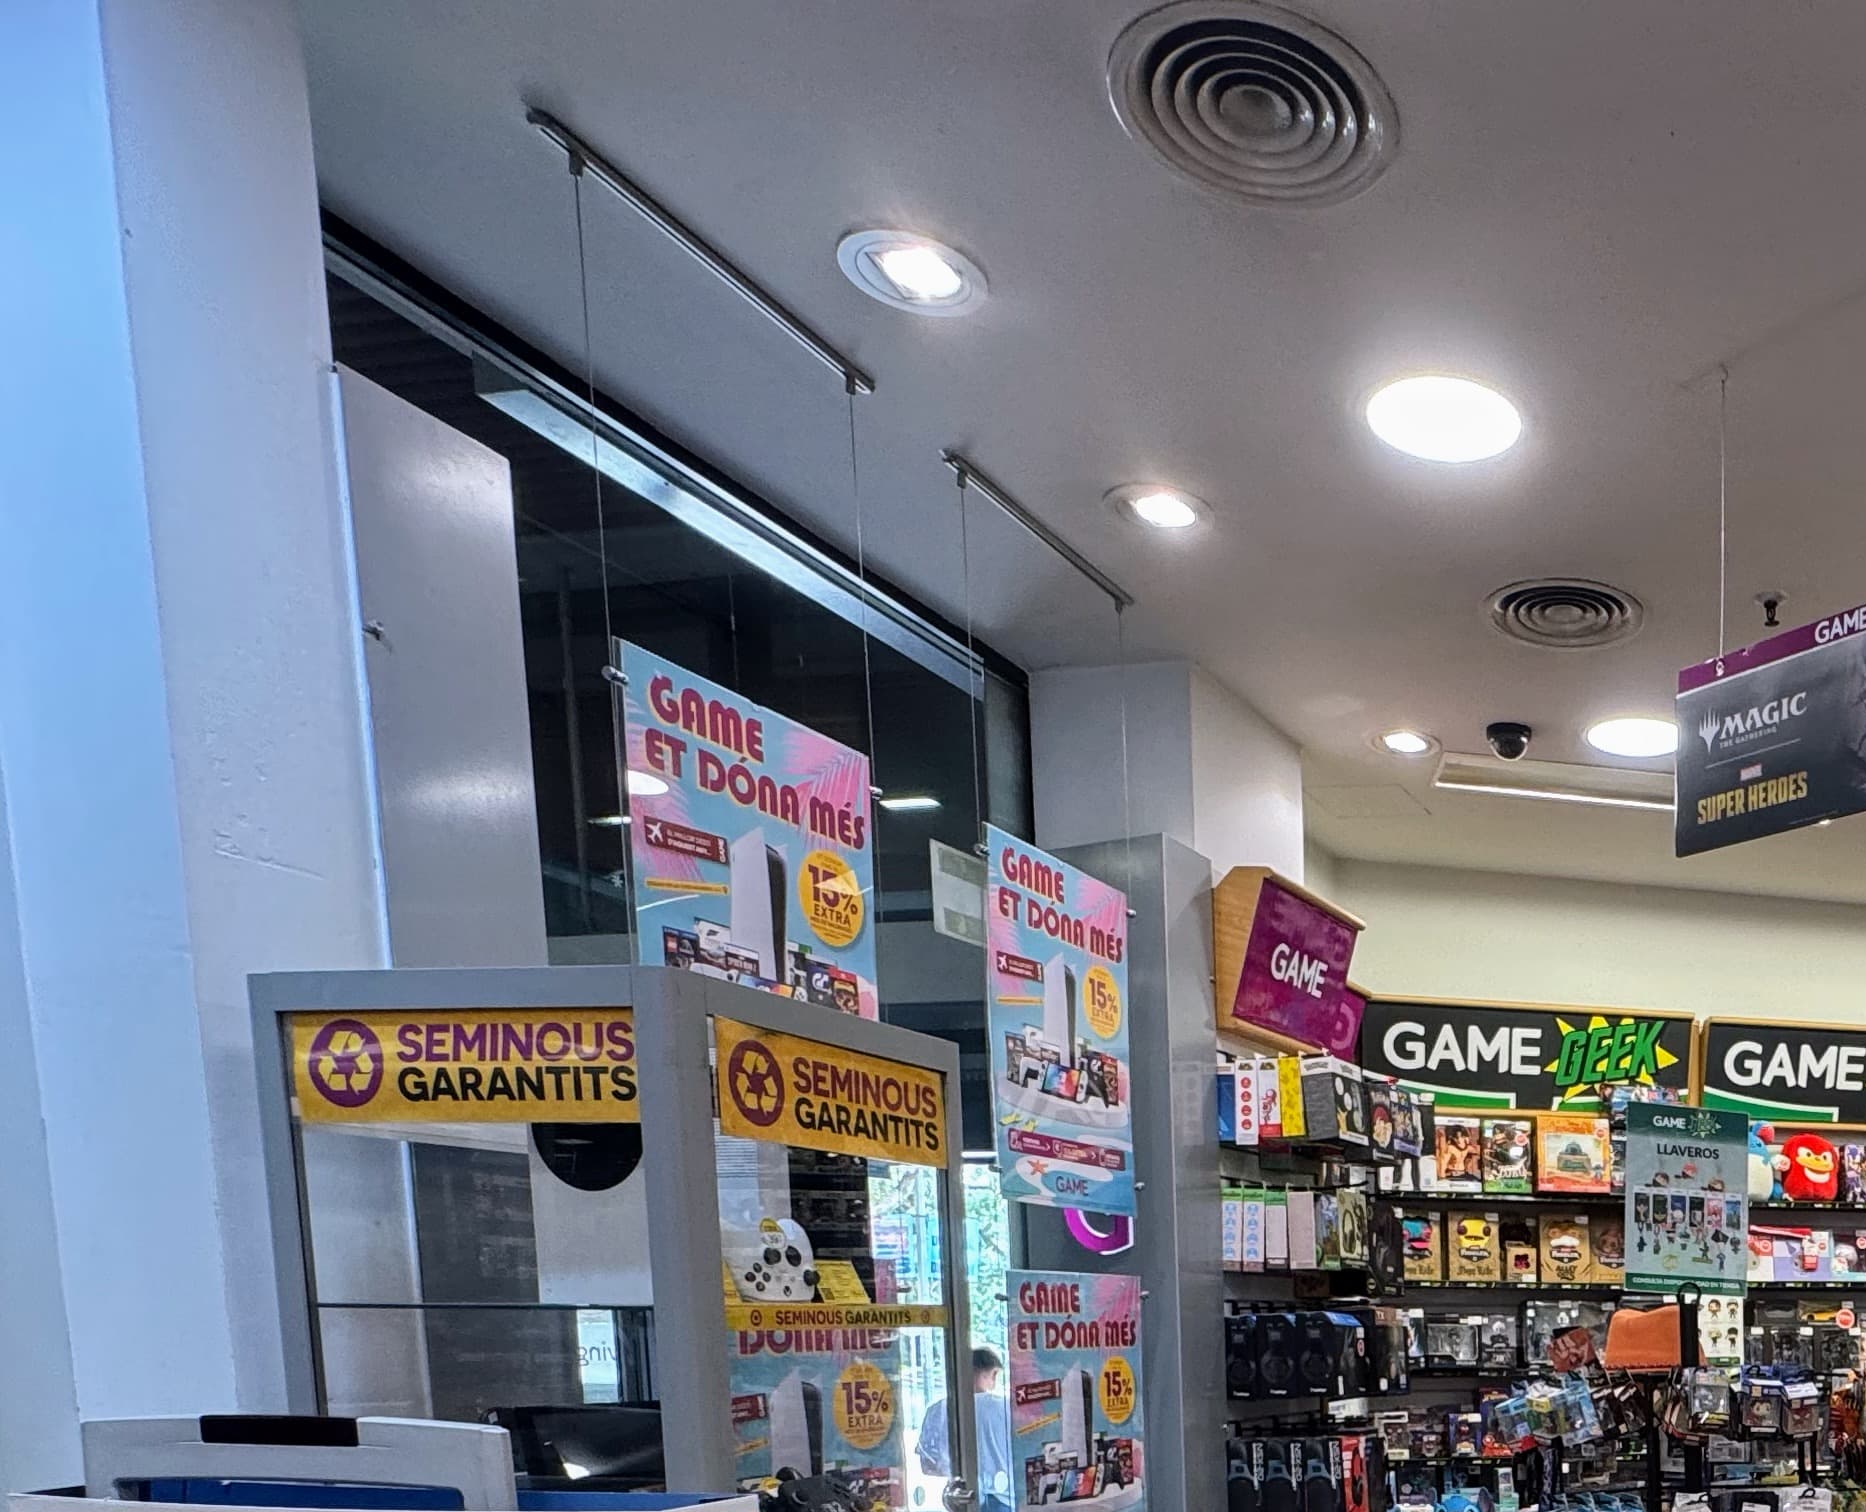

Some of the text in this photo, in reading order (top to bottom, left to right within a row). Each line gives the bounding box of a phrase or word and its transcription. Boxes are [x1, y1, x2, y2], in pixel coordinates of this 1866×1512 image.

[650, 675, 764, 763] GAME
[1720, 692, 1807, 739] MAGIC
[645, 728, 864, 850] ET DÓNA MÉS
[1697, 788, 1745, 825] SUPER
[1748, 771, 1808, 811] HEROES
[1002, 847, 1064, 904] GAME
[814, 904, 850, 927] EXTRA
[999, 887, 1123, 963] ET DÓNA MÉS
[1271, 944, 1328, 998] GAME
[1089, 979, 1118, 1013] 15%
[397, 1021, 635, 1063] SEMINOUS
[1383, 1020, 1665, 1086] GAME GEEK
[399, 1066, 637, 1103] GARANTITS
[1724, 1041, 1866, 1091] GAME
[793, 1057, 937, 1119] SEMINOUS
[793, 1097, 939, 1151] GARANTITS
[1653, 1116, 1686, 1130] GAME
[1657, 1143, 1720, 1160] LLAVEROS
[1056, 1176, 1088, 1196] GAME
[1020, 1281, 1080, 1313] GAME
[776, 1309, 911, 1326] SEMINOUS GARANTITS
[1017, 1314, 1136, 1350] ET DÓNA MÉS
[842, 1381, 888, 1415] 15%
[1104, 1371, 1132, 1396] 15%
[848, 1415, 883, 1428] EXTRA
